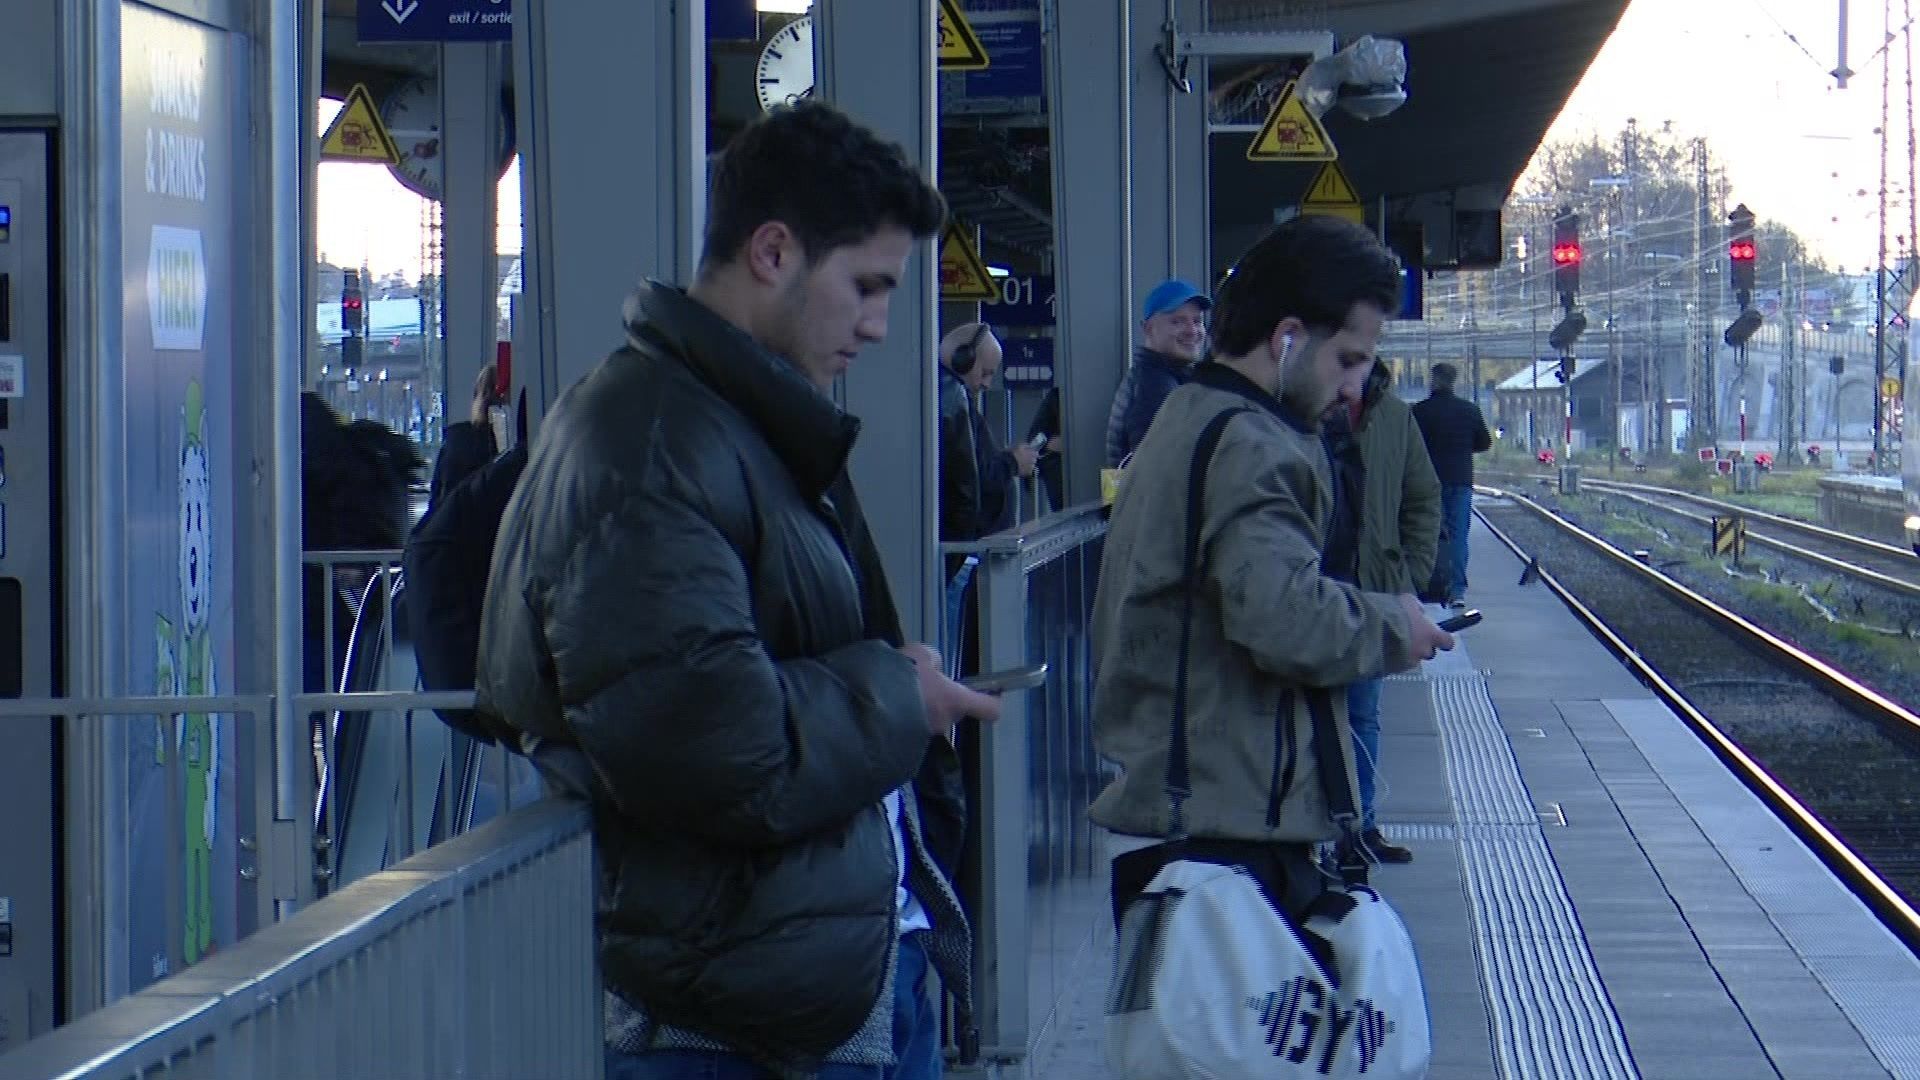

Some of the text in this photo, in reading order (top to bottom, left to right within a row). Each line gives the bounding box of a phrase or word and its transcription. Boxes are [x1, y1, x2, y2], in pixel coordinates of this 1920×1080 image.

[449, 12, 470, 24] exit
[481, 11, 513, 24] sortie
[145, 127, 206, 202] & DRINKS
[986, 277, 1033, 305] 01
